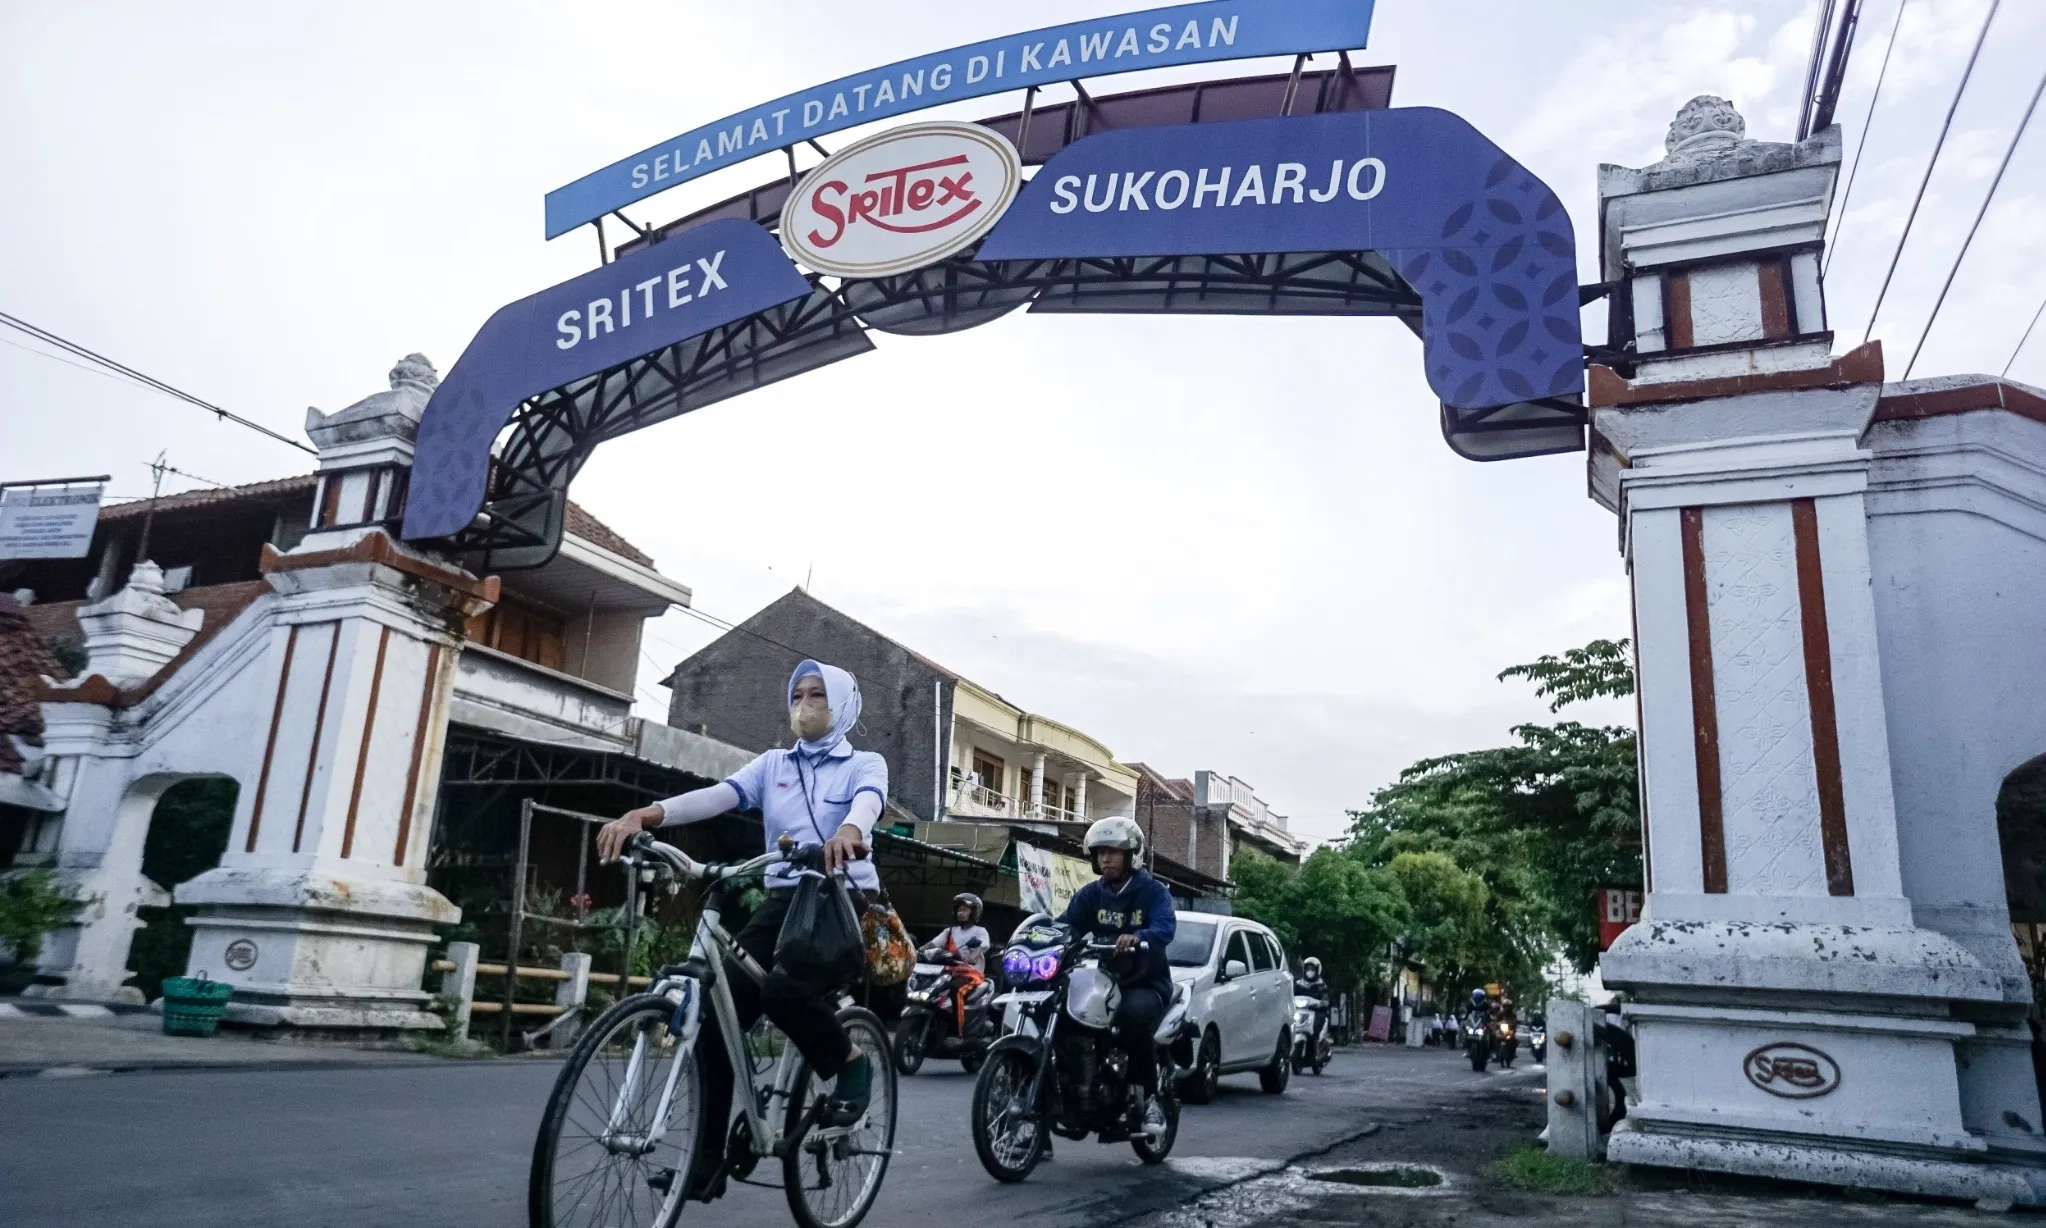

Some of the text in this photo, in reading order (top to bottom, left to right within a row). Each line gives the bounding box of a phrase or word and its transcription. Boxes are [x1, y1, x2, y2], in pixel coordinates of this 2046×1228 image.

[631, 15, 1239, 189] SELAMAT DATANG DI KAWASAN
[1049, 156, 1387, 215] SUKOHARJO
[555, 249, 729, 351] SRITEX
